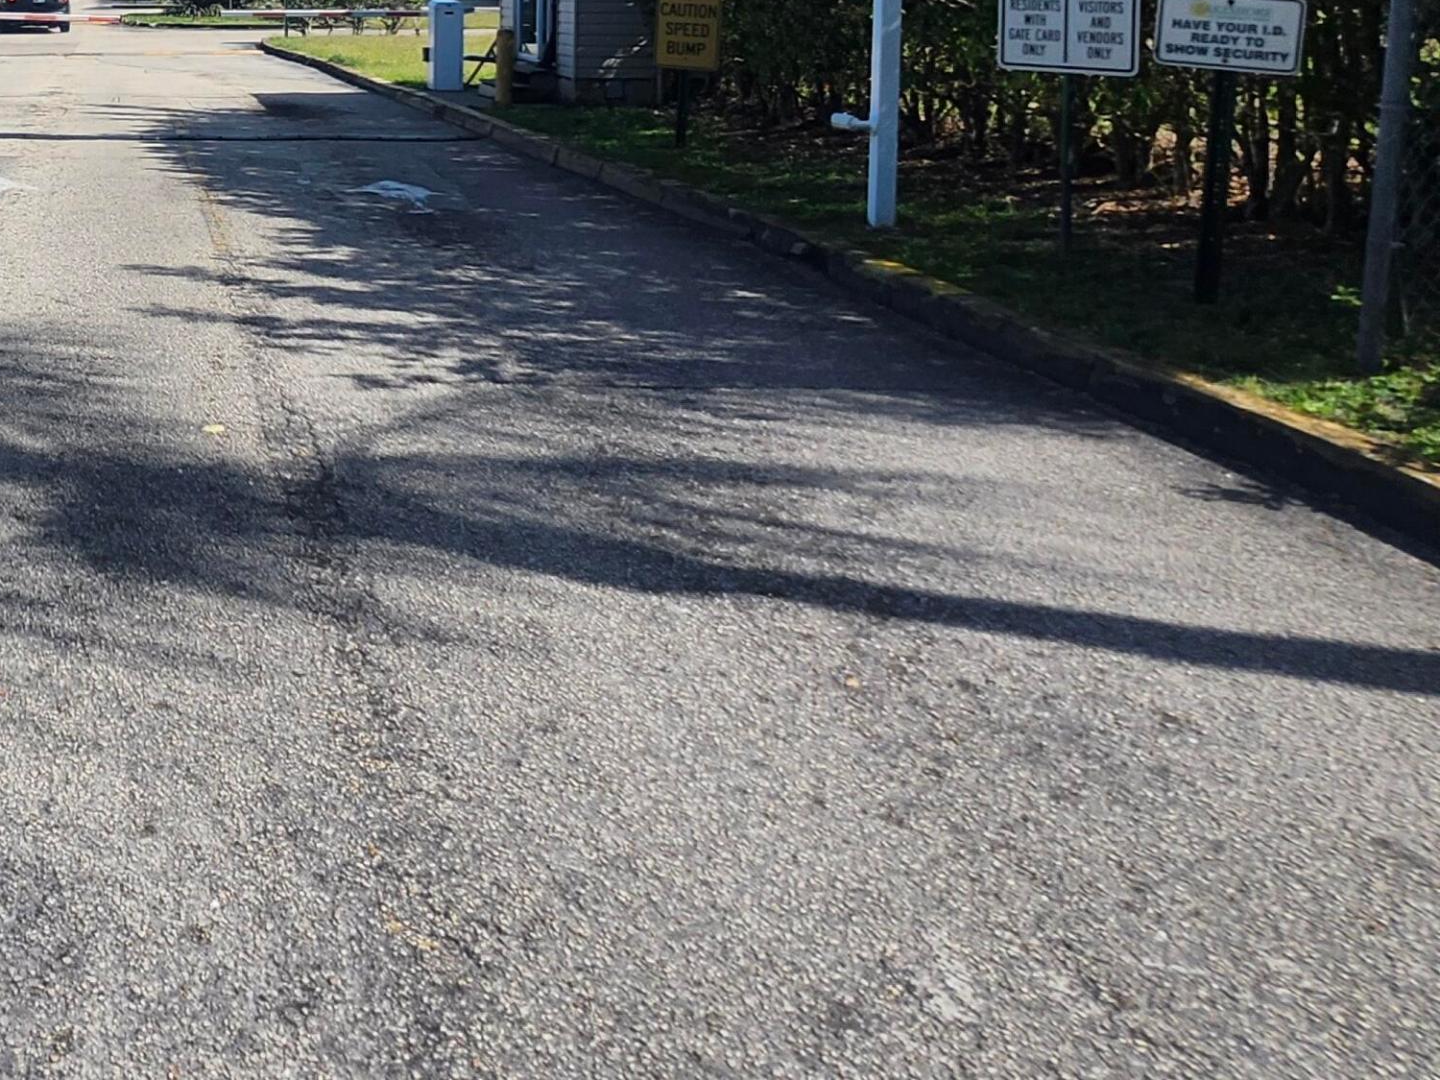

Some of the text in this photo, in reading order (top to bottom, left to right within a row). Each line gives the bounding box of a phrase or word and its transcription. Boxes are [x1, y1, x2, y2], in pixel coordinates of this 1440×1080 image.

[660, 2, 718, 18] CAUTION
[1078, 0, 1124, 14] VISITORS
[1024, 14, 1047, 26] WITH
[1090, 16, 1112, 29] AND
[1172, 19, 1287, 36] HAVE YOUR I.D.
[665, 22, 710, 38] SPEED
[1077, 31, 1124, 45] VENDORS
[1191, 32, 1265, 48] READY TO
[666, 40, 706, 57] BUMP
[1022, 43, 1047, 56] ONLY
[1087, 46, 1113, 60] ONLY
[1165, 43, 1289, 63] SHOW SECURITY
